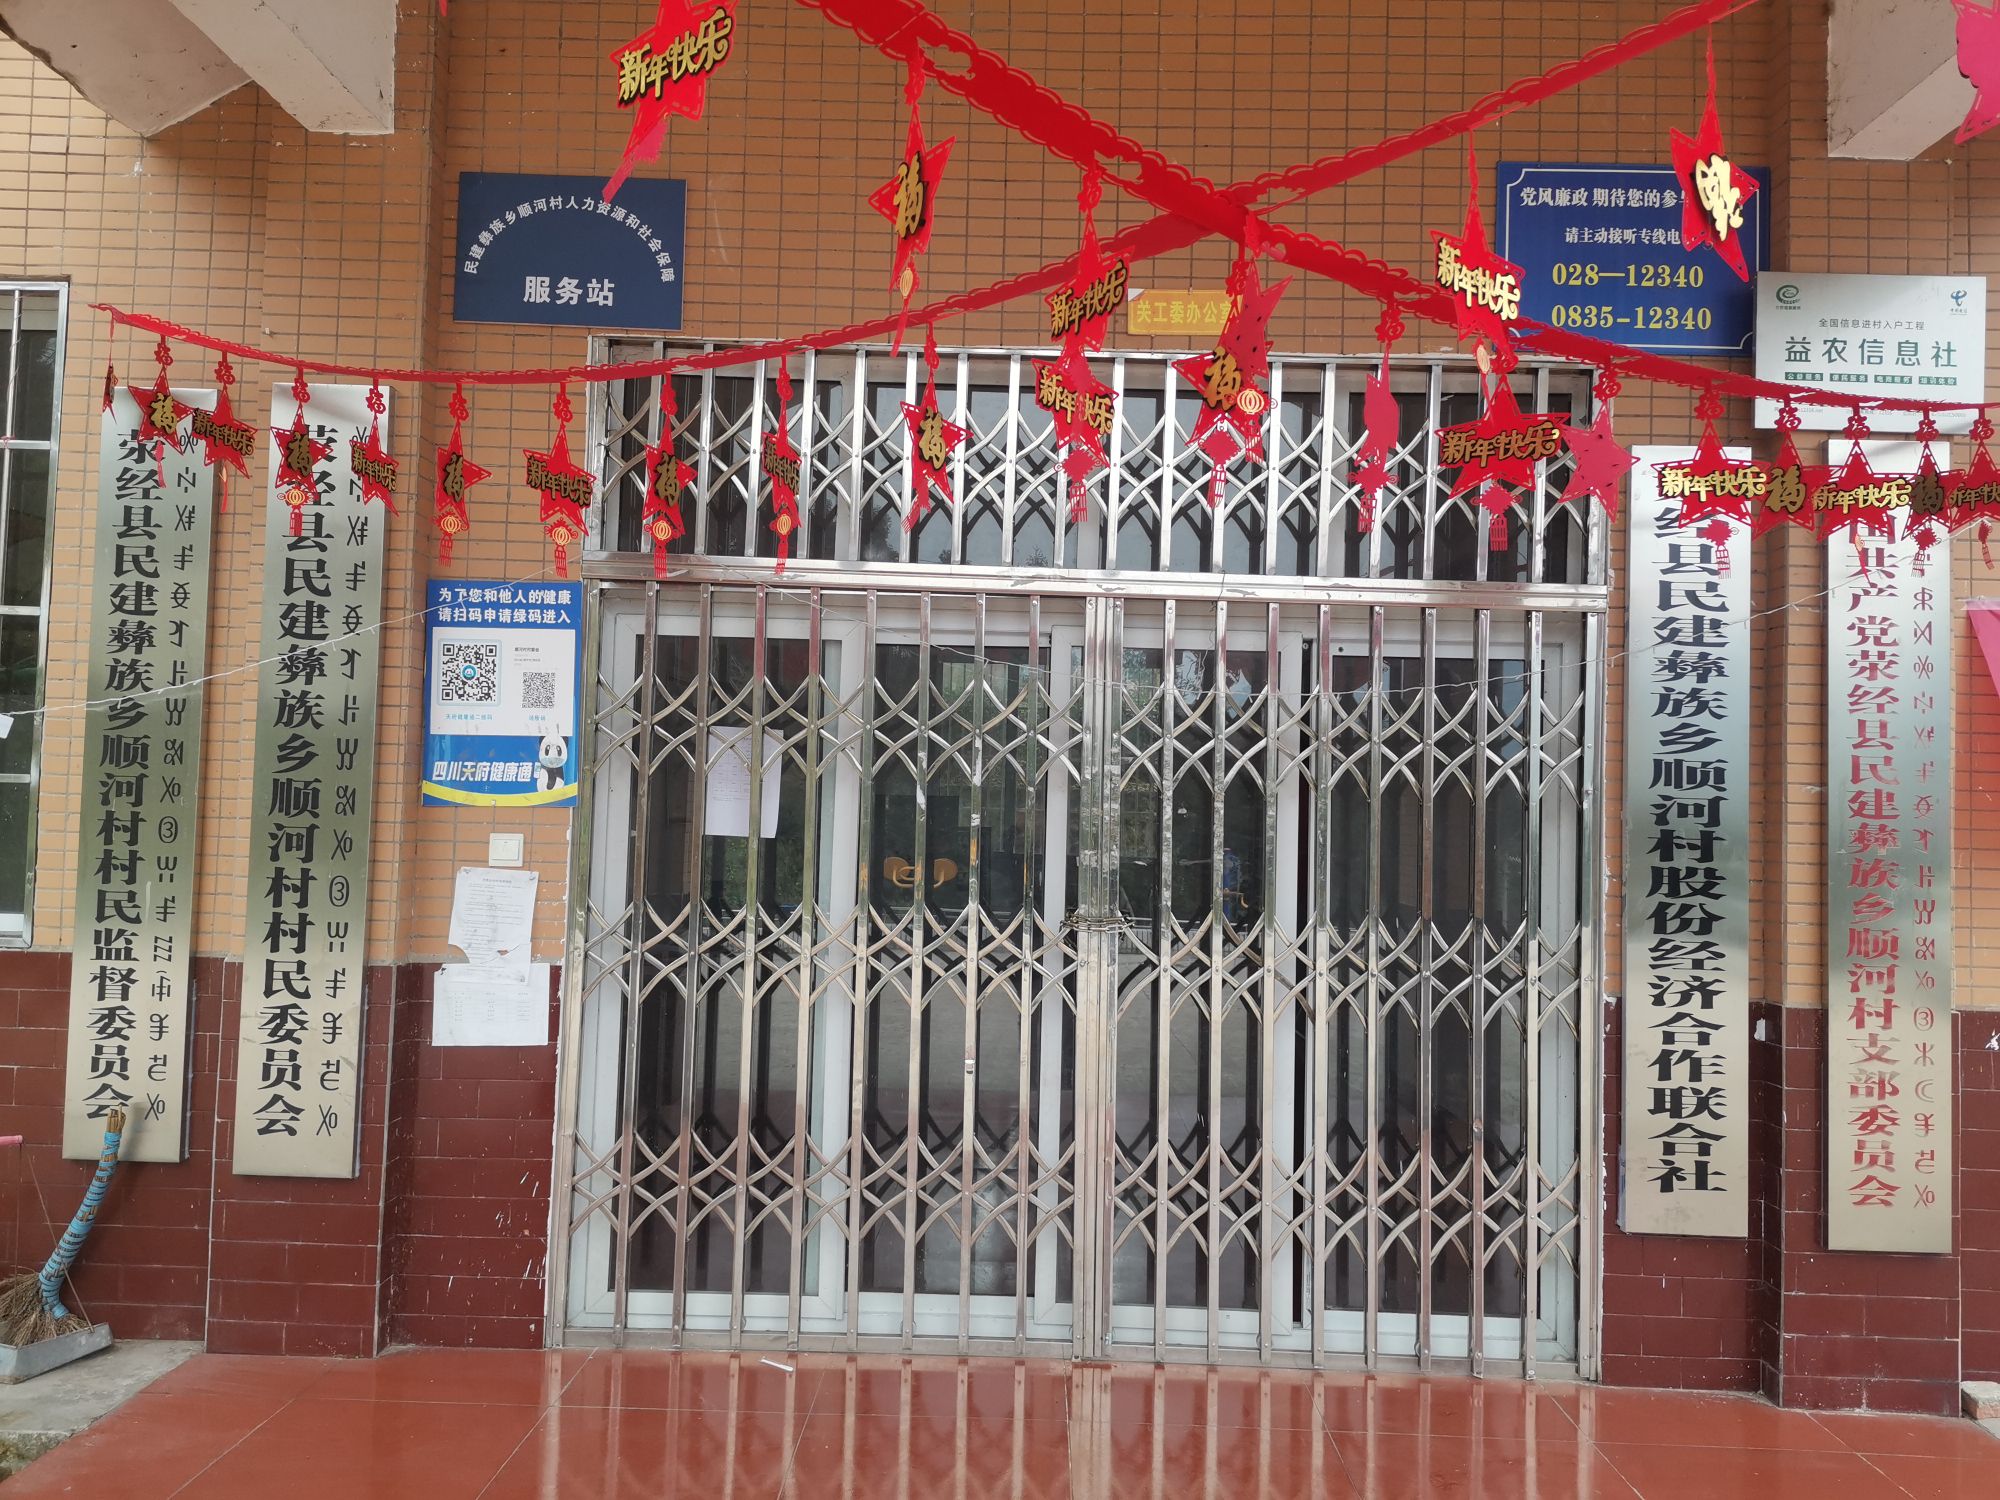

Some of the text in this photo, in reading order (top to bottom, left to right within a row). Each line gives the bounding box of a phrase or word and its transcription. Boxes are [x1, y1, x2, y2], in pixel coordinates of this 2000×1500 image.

[618, 8, 733, 103] 新年快乐
[1520, 186, 1588, 207] 党风廉政
[463, 194, 675, 283] 民建彝族乡顺河村人力资源和社会保障
[1565, 227, 1682, 246] 请主动接听专线电
[523, 275, 615, 306] 服务站
[1051, 259, 1128, 338] 新年快乐
[1437, 238, 1521, 321] 新年快乐
[1551, 305, 1712, 331] 0835-12340
[1818, 317, 1925, 331] 全国信息进村入户工程
[1784, 335, 1958, 368] 益农信息社
[149, 391, 177, 433] 福
[193, 407, 255, 456] 新年快乐
[287, 433, 313, 476] 福
[919, 406, 947, 470] 福
[1442, 420, 1560, 467] 新年快乐
[352, 445, 397, 492] 新年快乐
[526, 456, 593, 507] 新年快乐
[1660, 465, 1767, 502] 新年快乐
[1766, 466, 1806, 513] 福
[1813, 479, 1913, 514] 新年快乐
[438, 587, 572, 606] 为了您和他人的健康
[438, 607, 572, 625] 请扫码申请绿码进入
[82, 428, 166, 1120] 荥经县民建彝族乡顺河村村民监督委员会
[432, 760, 534, 782] 四川天府健康通
[1646, 478, 1731, 1193] 经县民建彝族乡顺河村股份经济合作联合社
